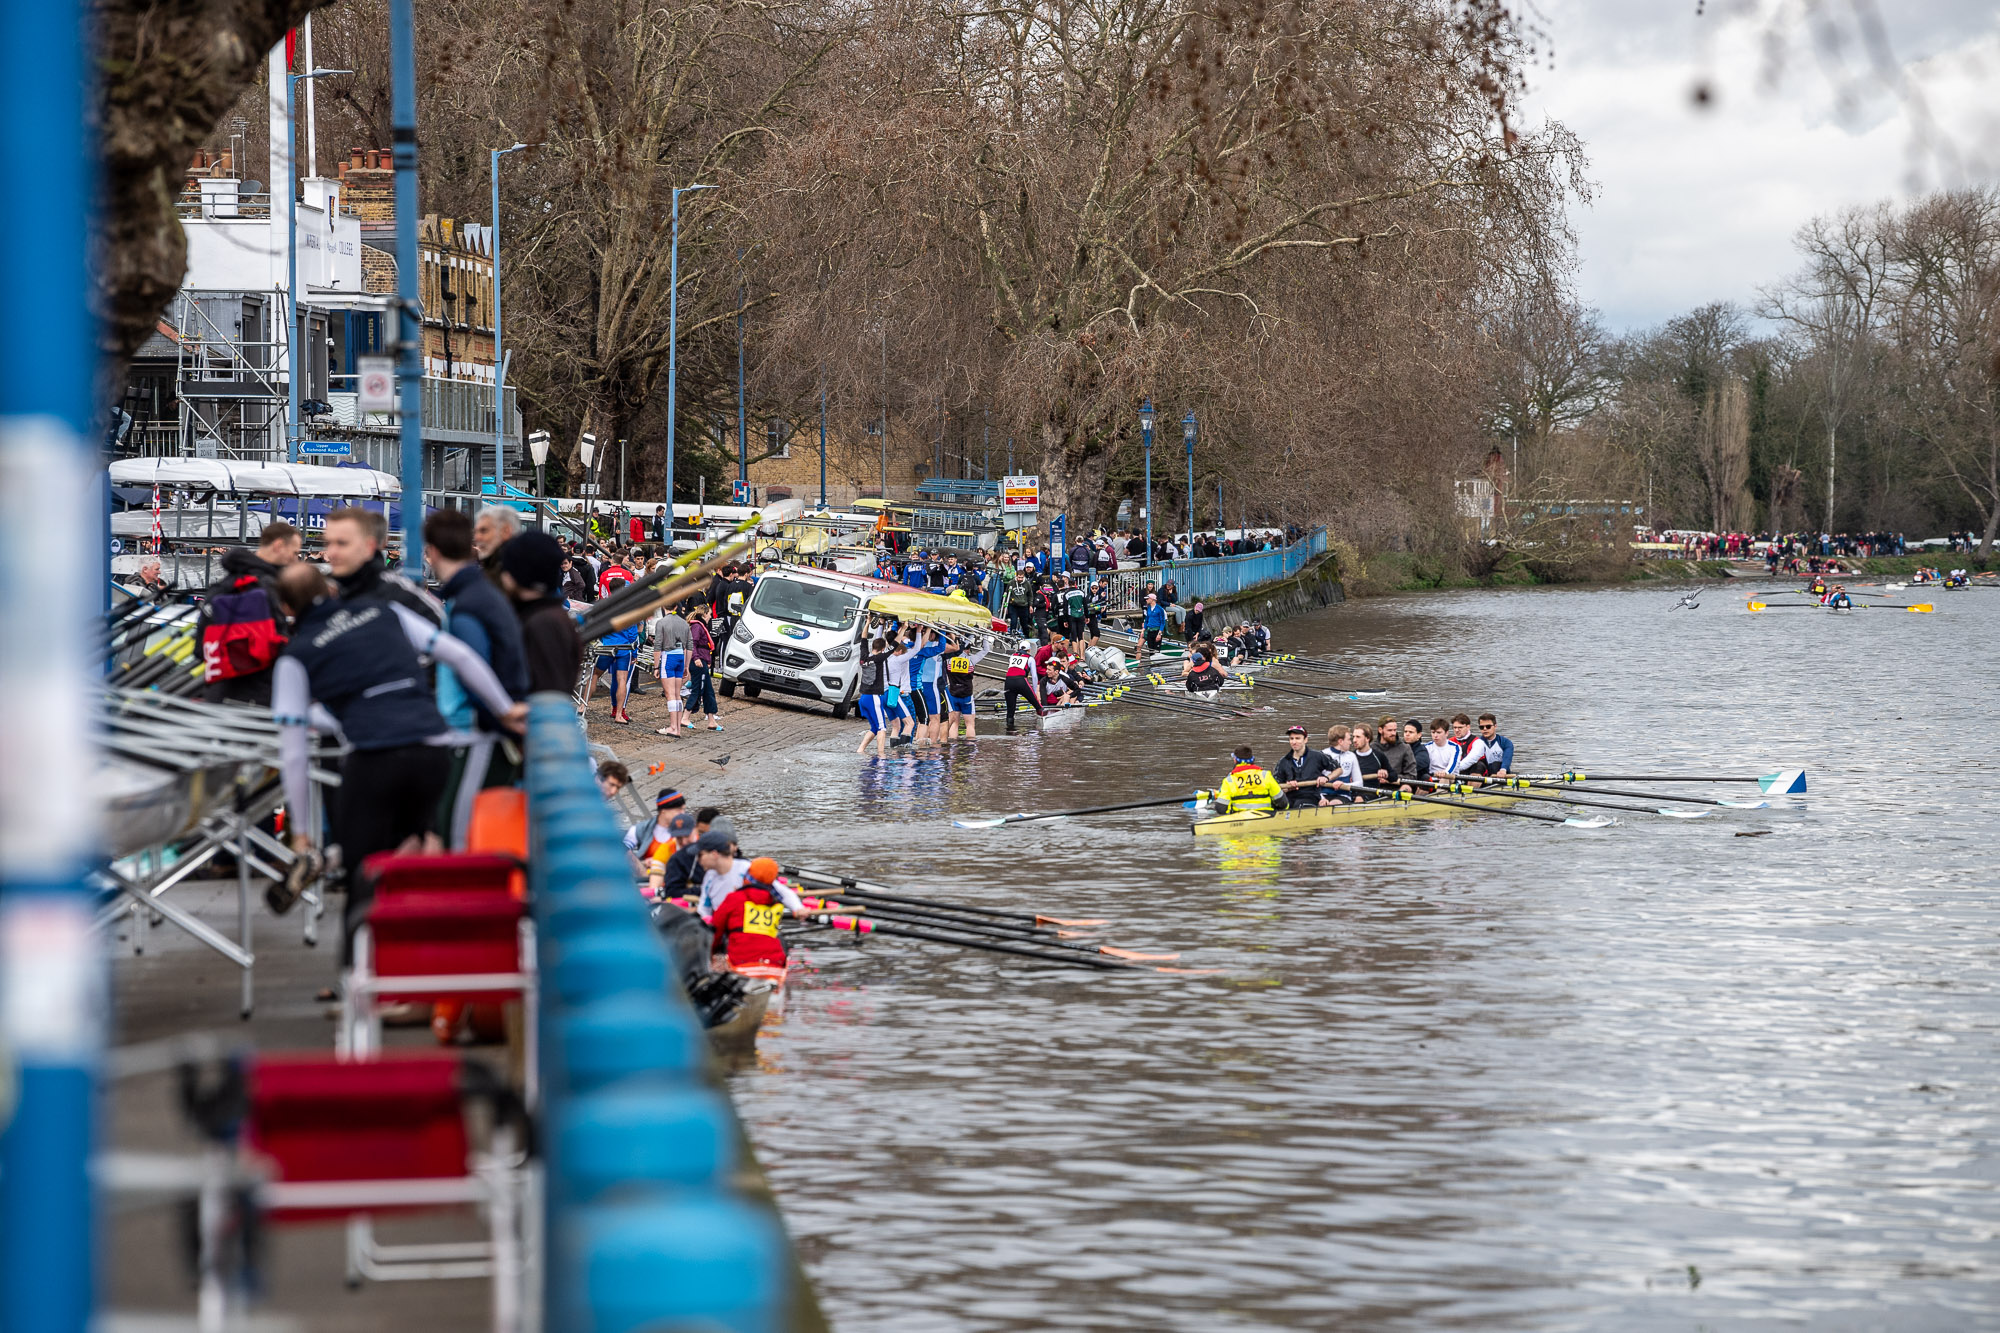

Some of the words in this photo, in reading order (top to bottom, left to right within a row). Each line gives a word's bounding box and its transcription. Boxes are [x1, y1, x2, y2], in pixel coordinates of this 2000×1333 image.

[203, 640, 222, 682] TYR
[951, 659, 968, 670] 148
[1011, 657, 1023, 666] 20
[767, 666, 782, 674] PN19
[782, 669, 796, 677] ZZG
[1237, 774, 1262, 789] 248
